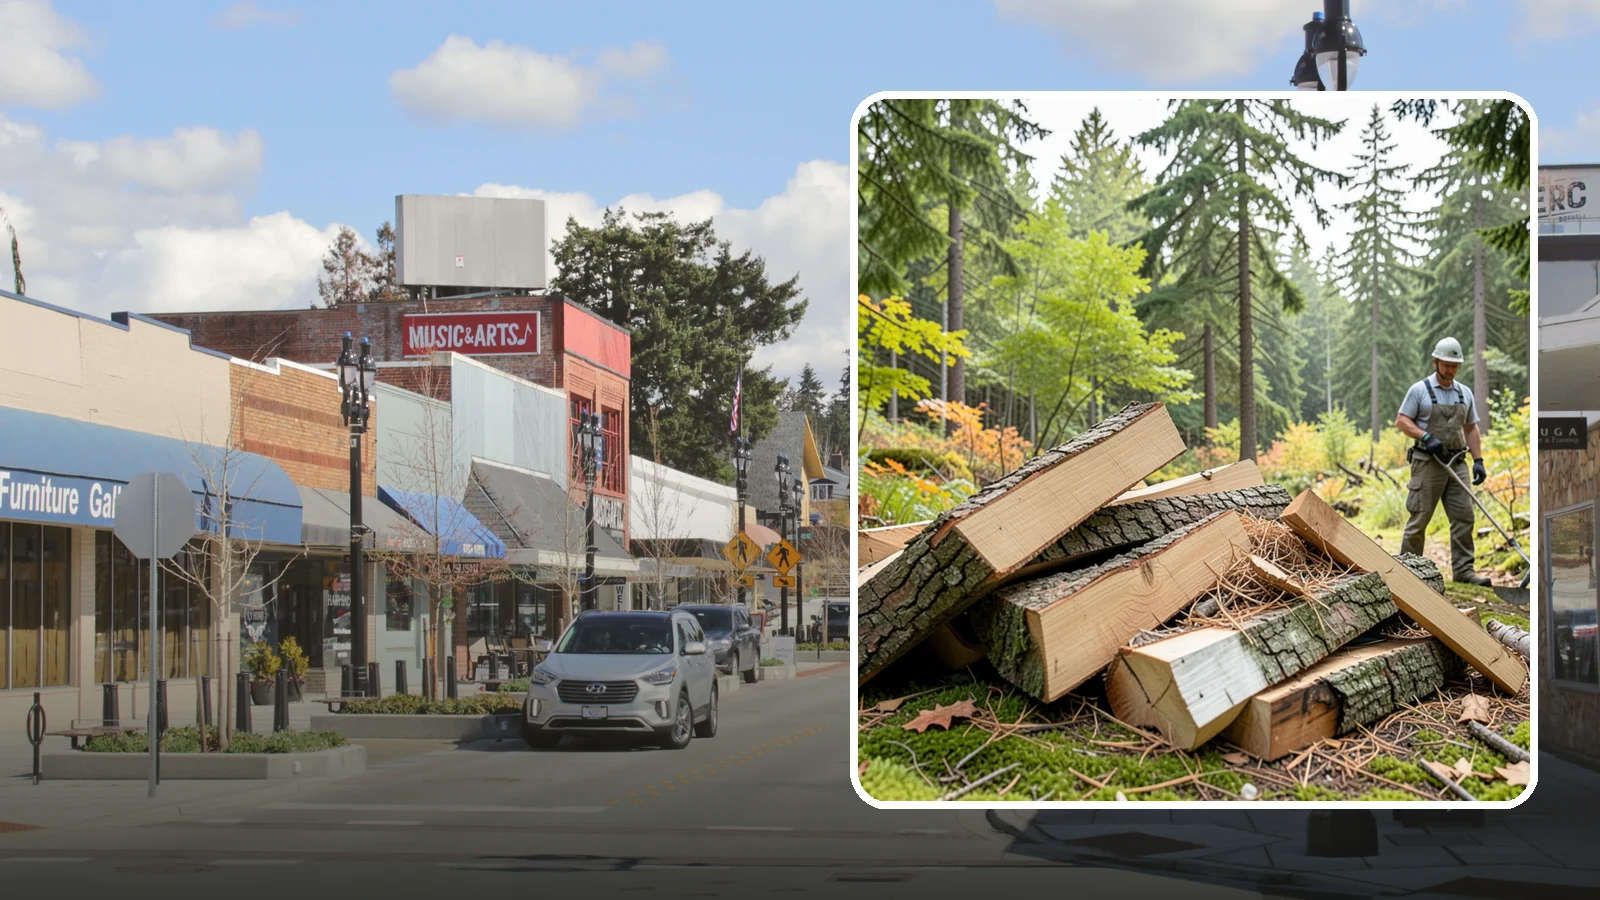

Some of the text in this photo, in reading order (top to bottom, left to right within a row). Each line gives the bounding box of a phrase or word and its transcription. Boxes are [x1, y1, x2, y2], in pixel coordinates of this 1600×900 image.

[408, 322, 520, 349] MUSIC&ARTS
[1552, 436, 1580, 445] Framing
[0, 472, 80, 515] Furniture
[453, 563, 479, 574] SUSHI
